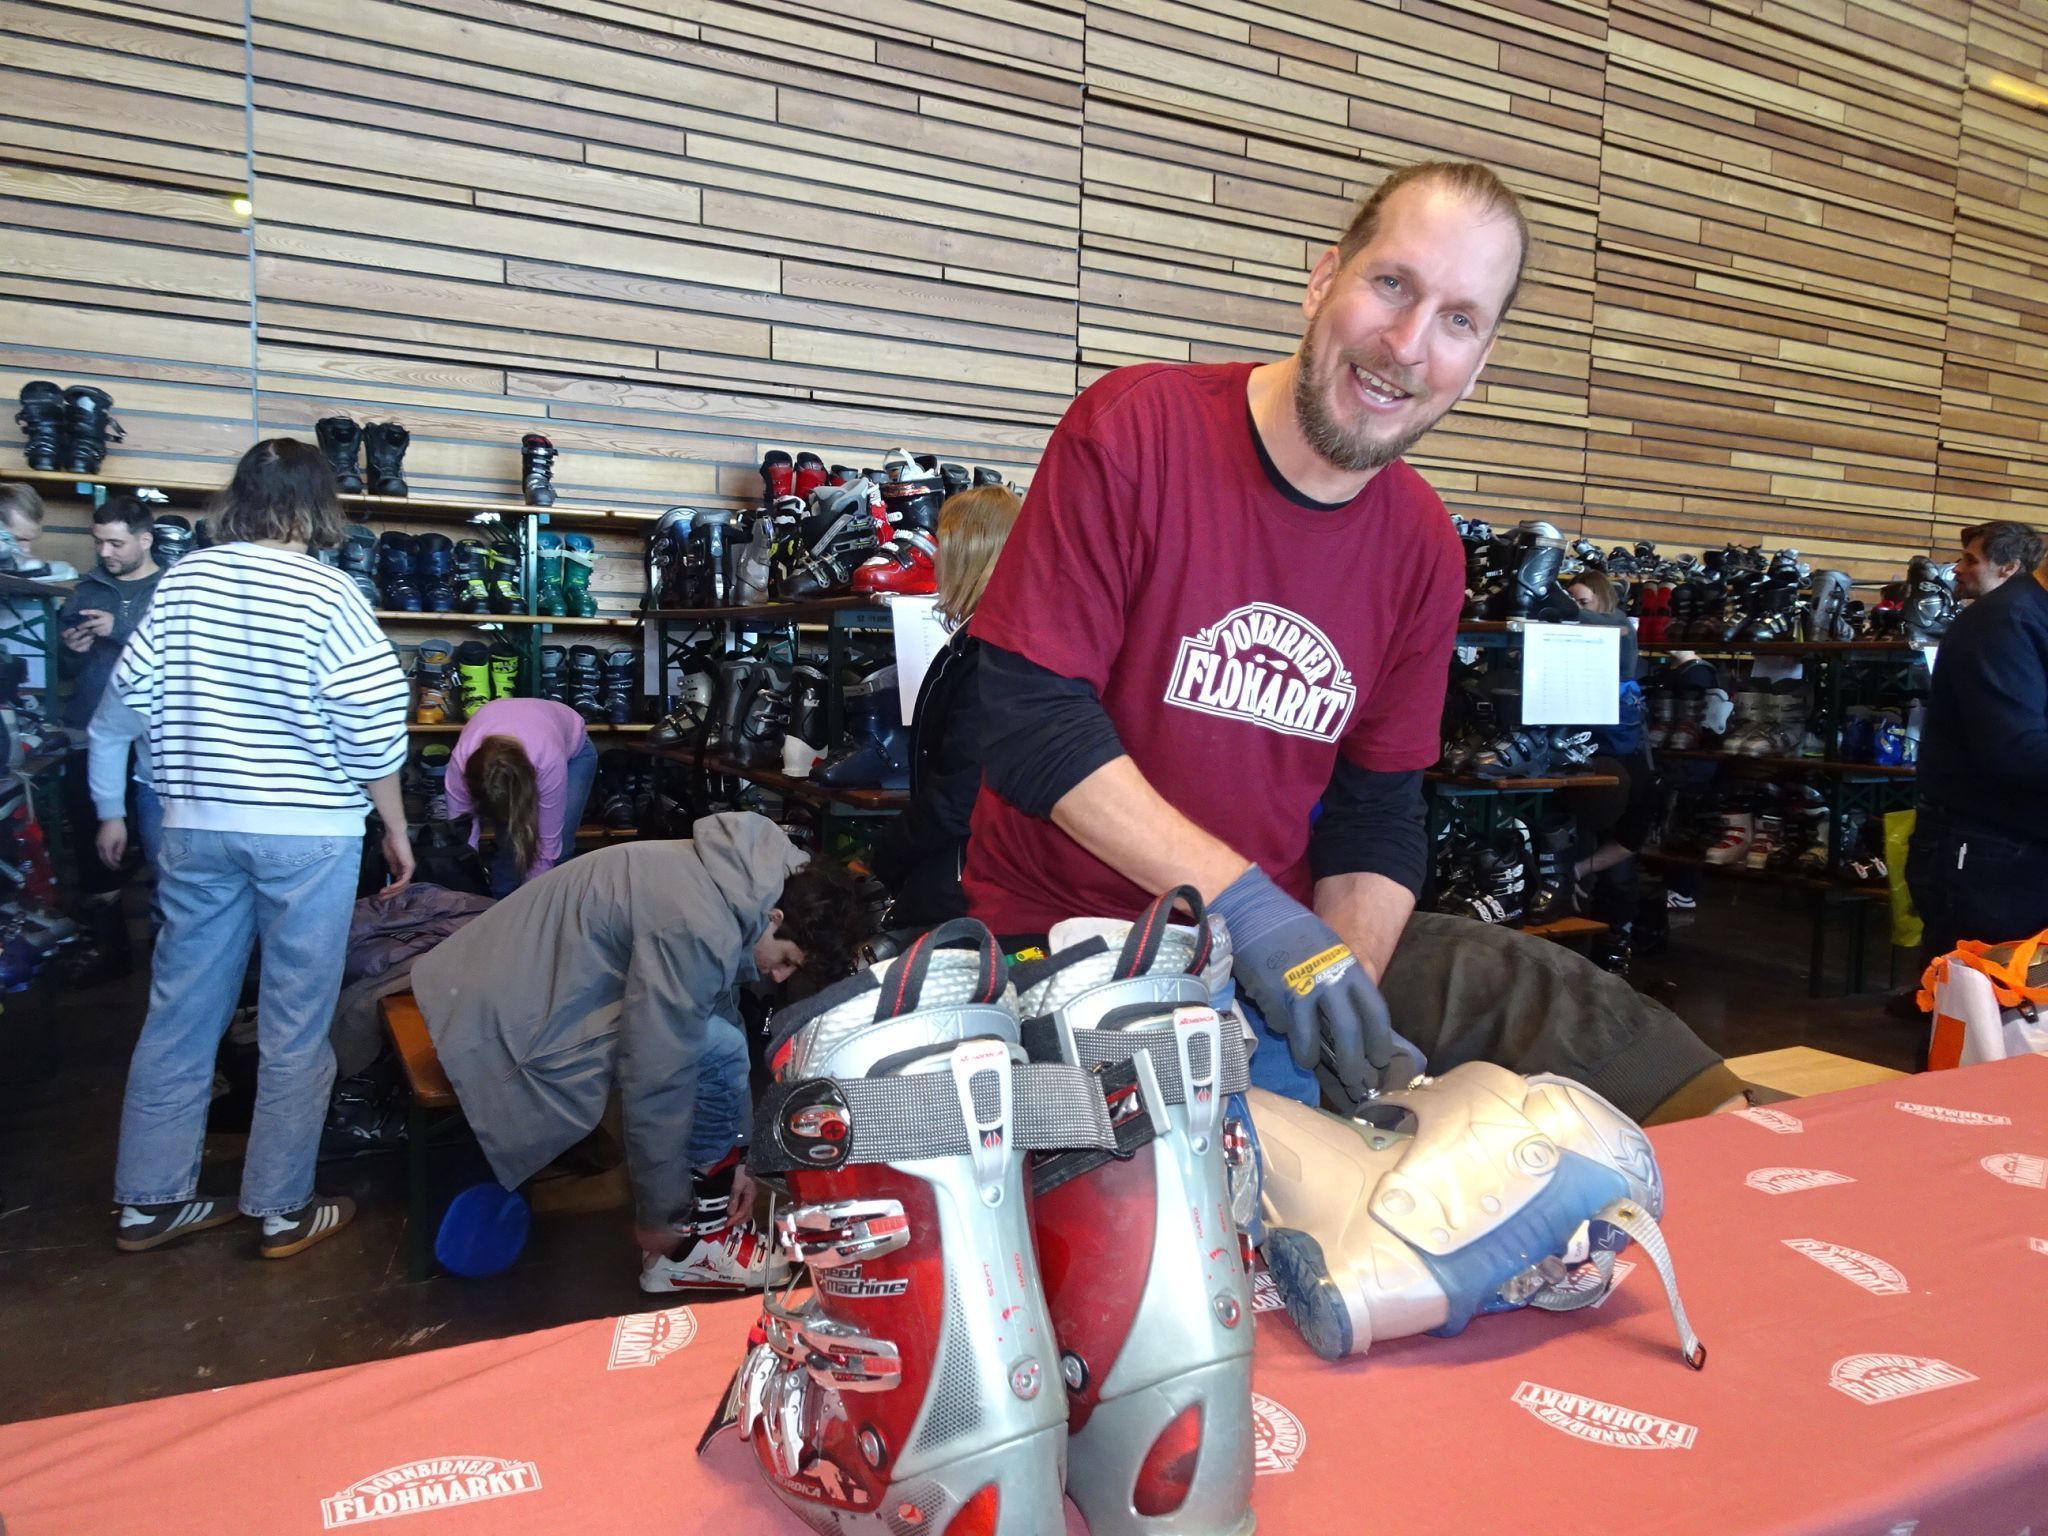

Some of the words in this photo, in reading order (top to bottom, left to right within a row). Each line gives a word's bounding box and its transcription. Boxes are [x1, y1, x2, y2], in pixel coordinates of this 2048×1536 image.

[983, 1263, 995, 1297] SOFT
[1840, 1363, 1967, 1402] FLOHMARKT
[1523, 1386, 1688, 1443] FLOHMARKT
[1539, 1407, 1658, 1446] DORNBIRNER
[333, 1467, 528, 1522] FLOHMARKT
[357, 1460, 495, 1495] DORNBIRNER
